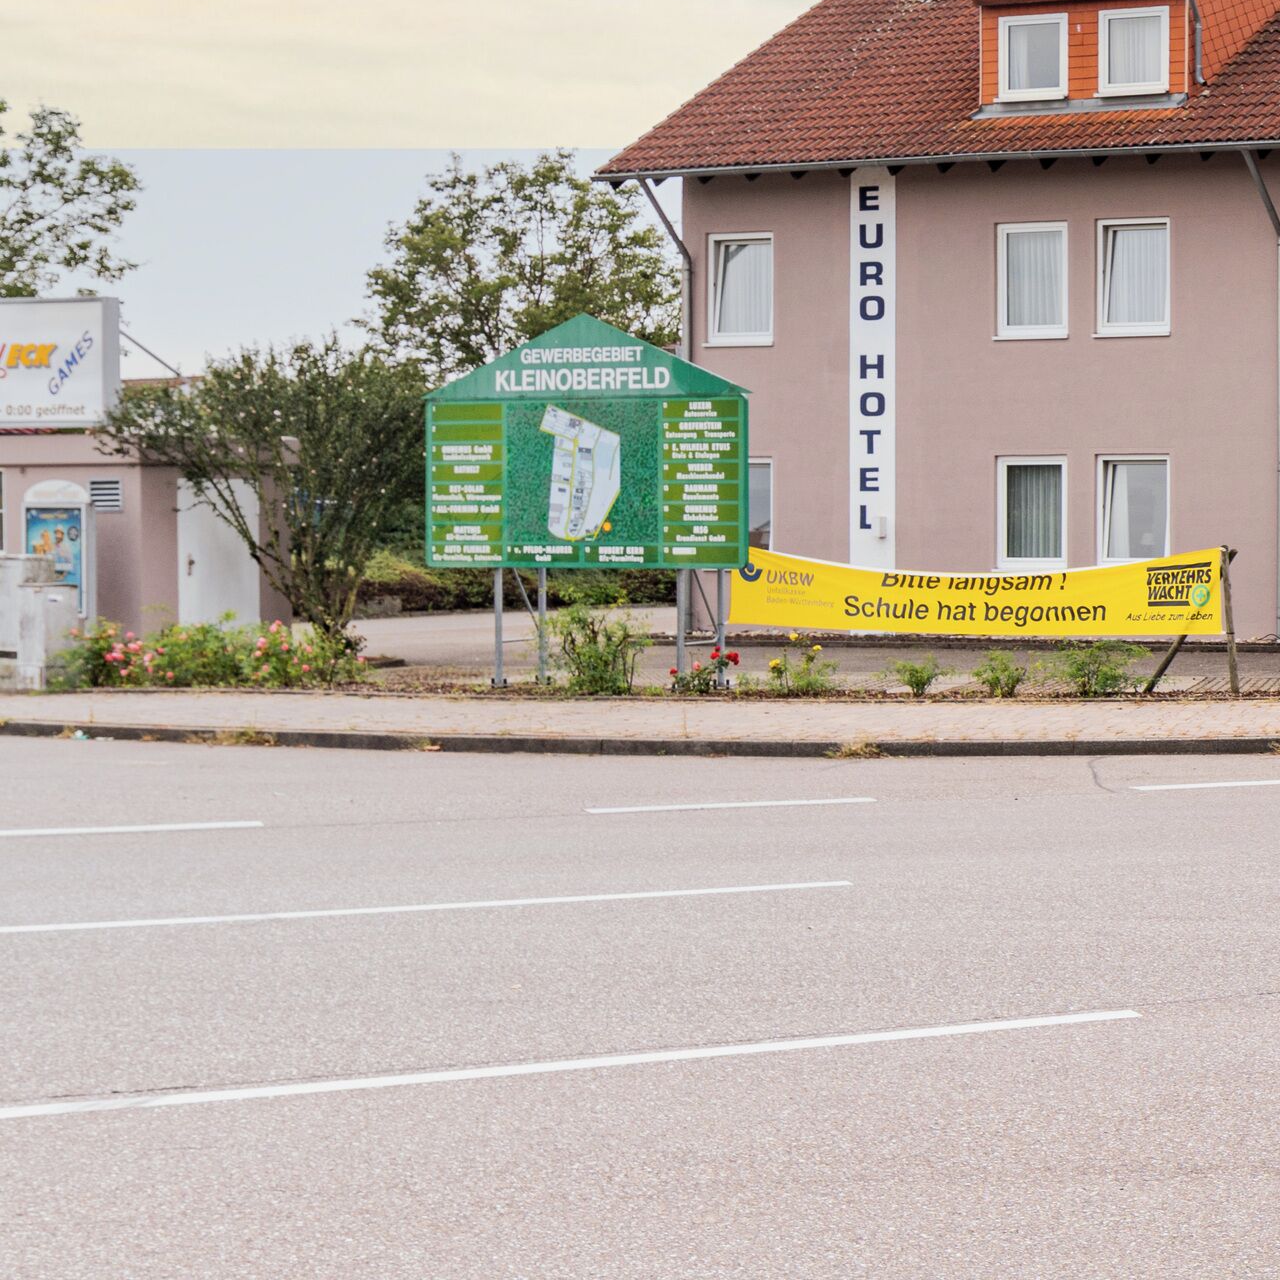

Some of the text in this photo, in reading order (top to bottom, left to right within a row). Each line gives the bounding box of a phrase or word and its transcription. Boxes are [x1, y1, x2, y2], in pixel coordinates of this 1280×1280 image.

[6, 342, 58, 368] ECK
[48, 330, 93, 395] GAMES
[521, 346, 643, 364] GEWERBEGEBIET
[859, 186, 886, 529] EURO HOTEL
[495, 367, 671, 392] KLEINOBERFELD
[6, 404, 85, 417] 0:00 geöffnet
[881, 573, 941, 589] Bitte
[948, 576, 1053, 596] langsam
[1147, 569, 1212, 586] VERKEHRS
[1148, 585, 1192, 600] WACHT
[844, 596, 1107, 628] Schule hat begonnen
[1126, 611, 1213, 621] Aus Liebe zum Leben
